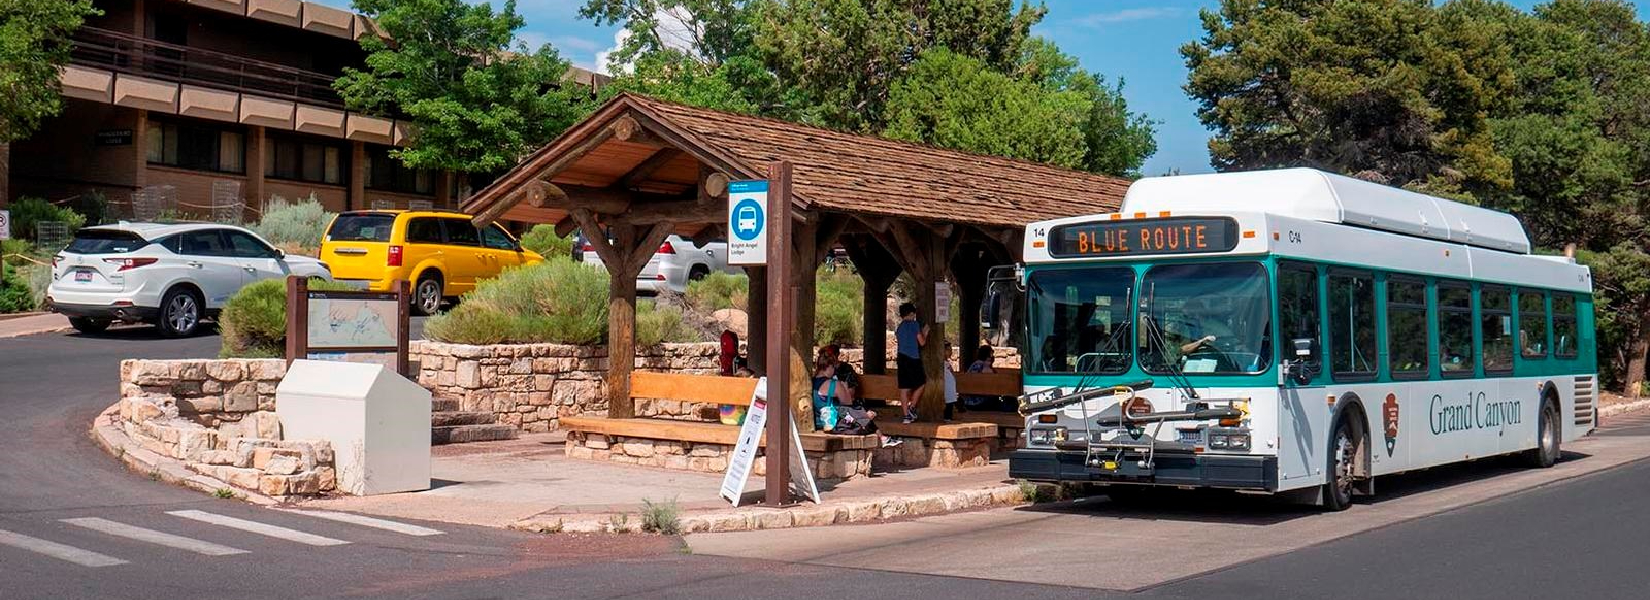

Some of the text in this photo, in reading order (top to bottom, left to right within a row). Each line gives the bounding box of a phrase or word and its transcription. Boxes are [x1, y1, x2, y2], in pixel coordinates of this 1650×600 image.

[1034, 228, 1045, 238] 14
[1078, 225, 1207, 254] BLUE ROUTE
[1429, 391, 1521, 436] Grand Canyon
